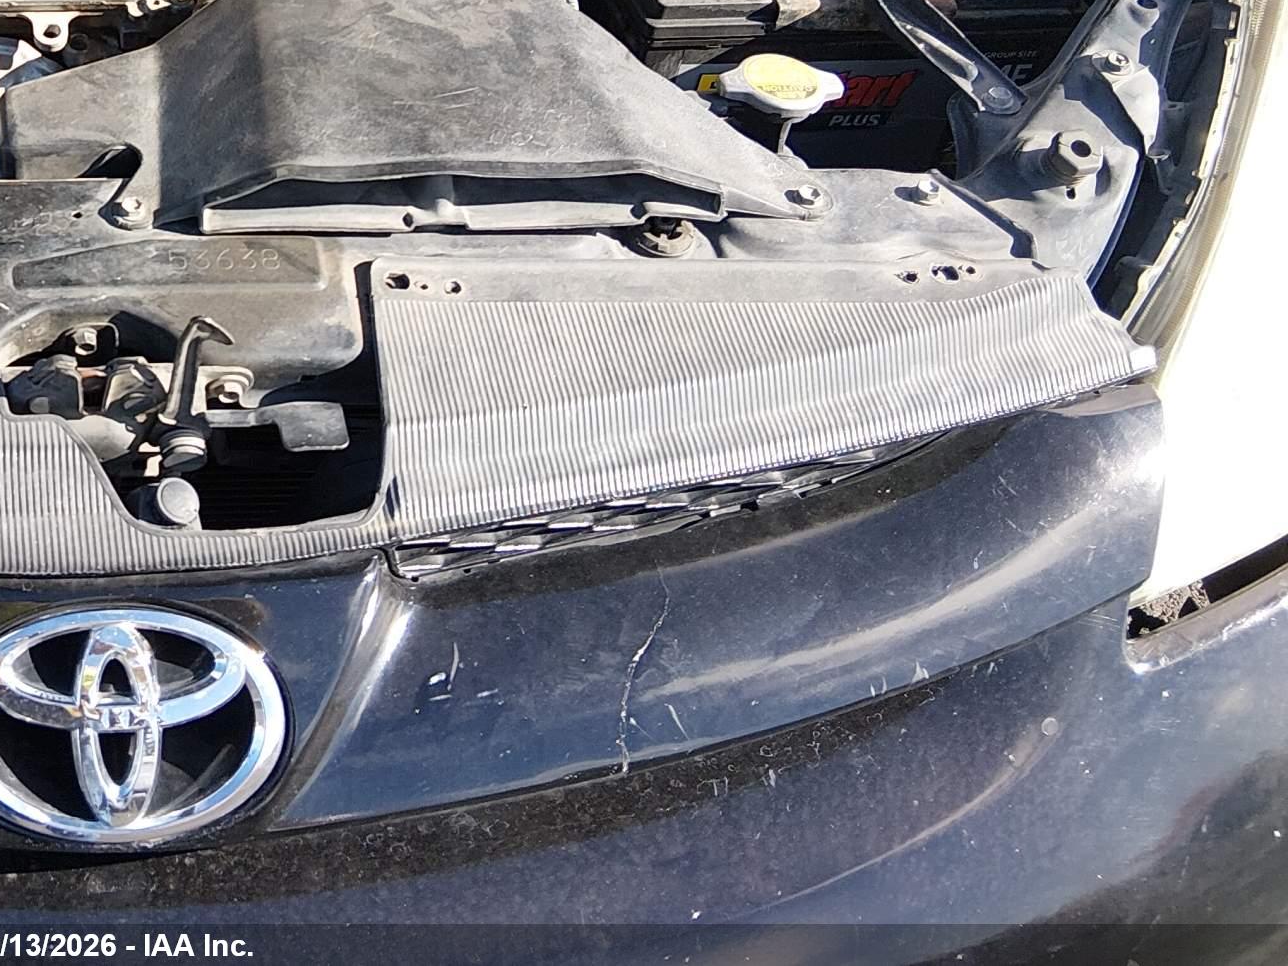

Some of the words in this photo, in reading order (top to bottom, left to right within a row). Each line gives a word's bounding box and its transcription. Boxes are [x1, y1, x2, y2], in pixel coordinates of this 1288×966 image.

[1017, 49, 1038, 58] SIZE
[828, 114, 881, 127] PLUS
[168, 247, 281, 271] 53638
